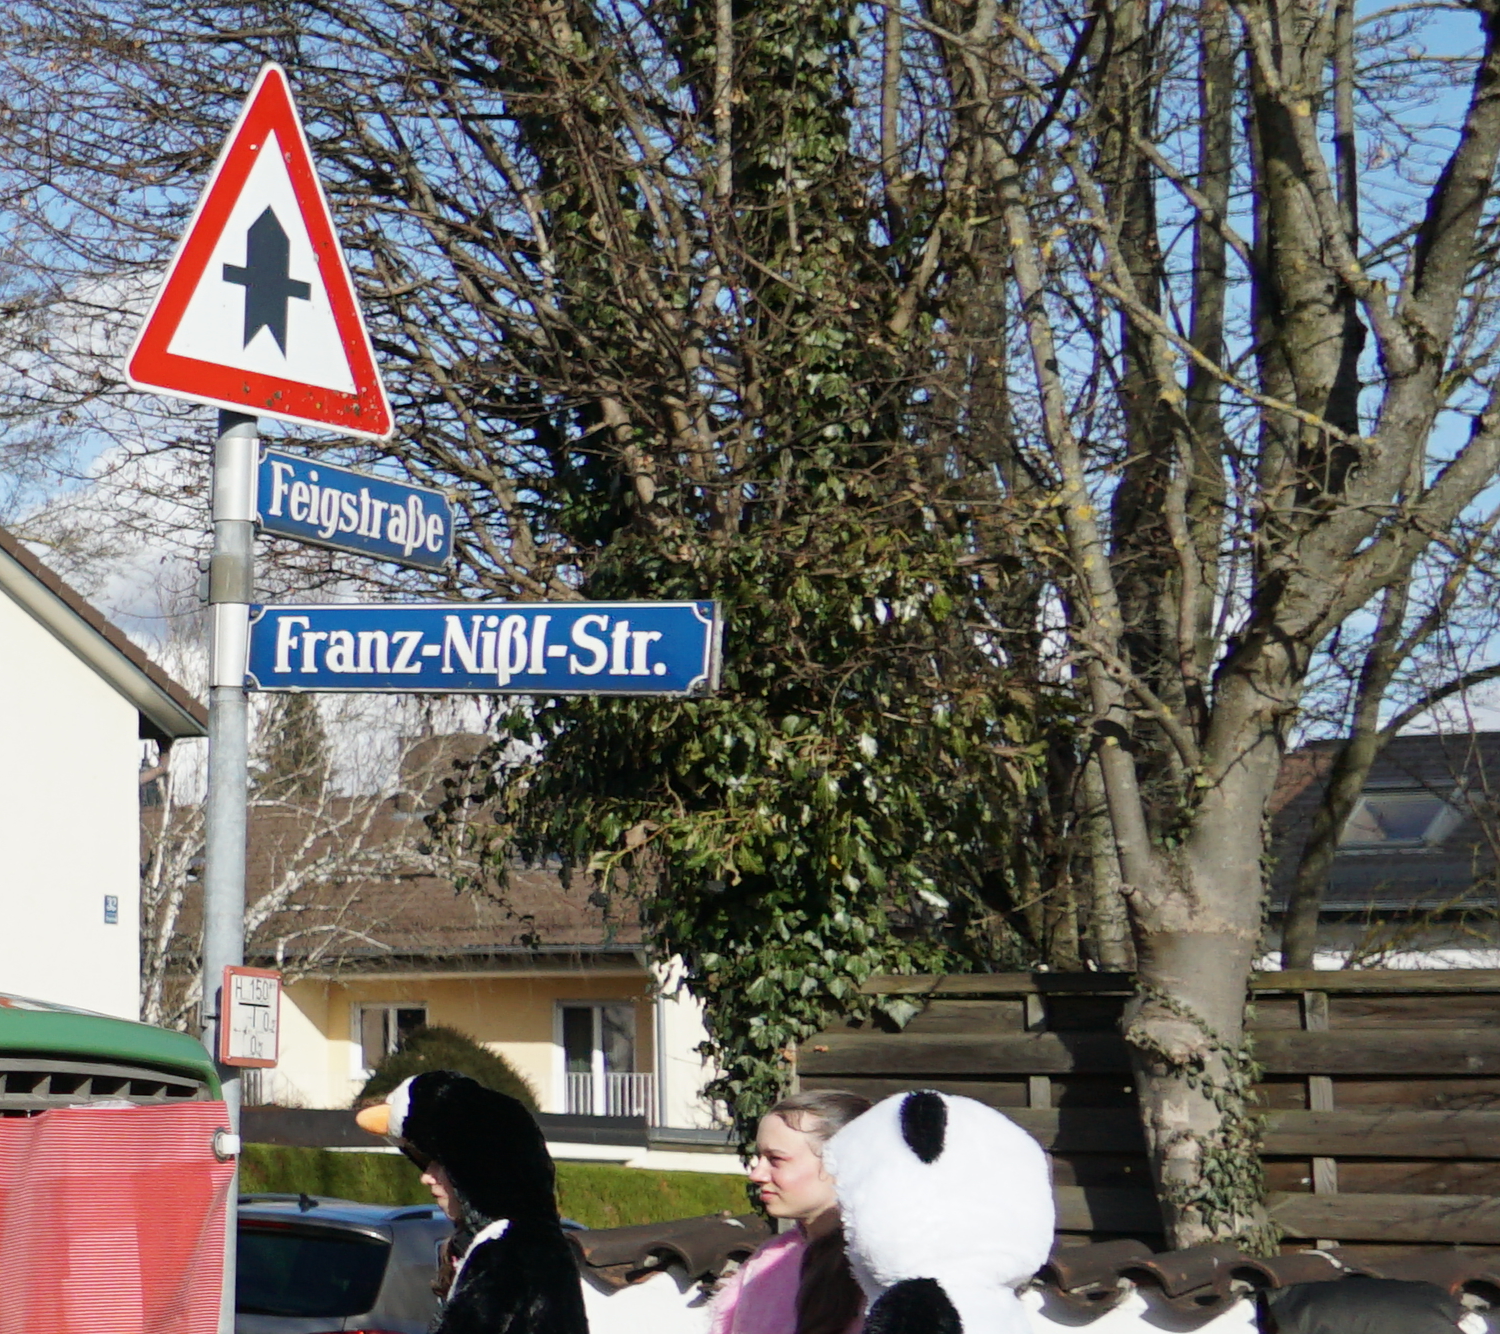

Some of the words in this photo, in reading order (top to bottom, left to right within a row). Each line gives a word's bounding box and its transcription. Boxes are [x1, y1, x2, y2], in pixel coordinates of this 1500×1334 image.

[268, 459, 444, 557] Feigstraße
[273, 614, 668, 687] Franz-Nißl-Str.
[235, 977, 243, 999] H
[250, 978, 269, 1001] 150
